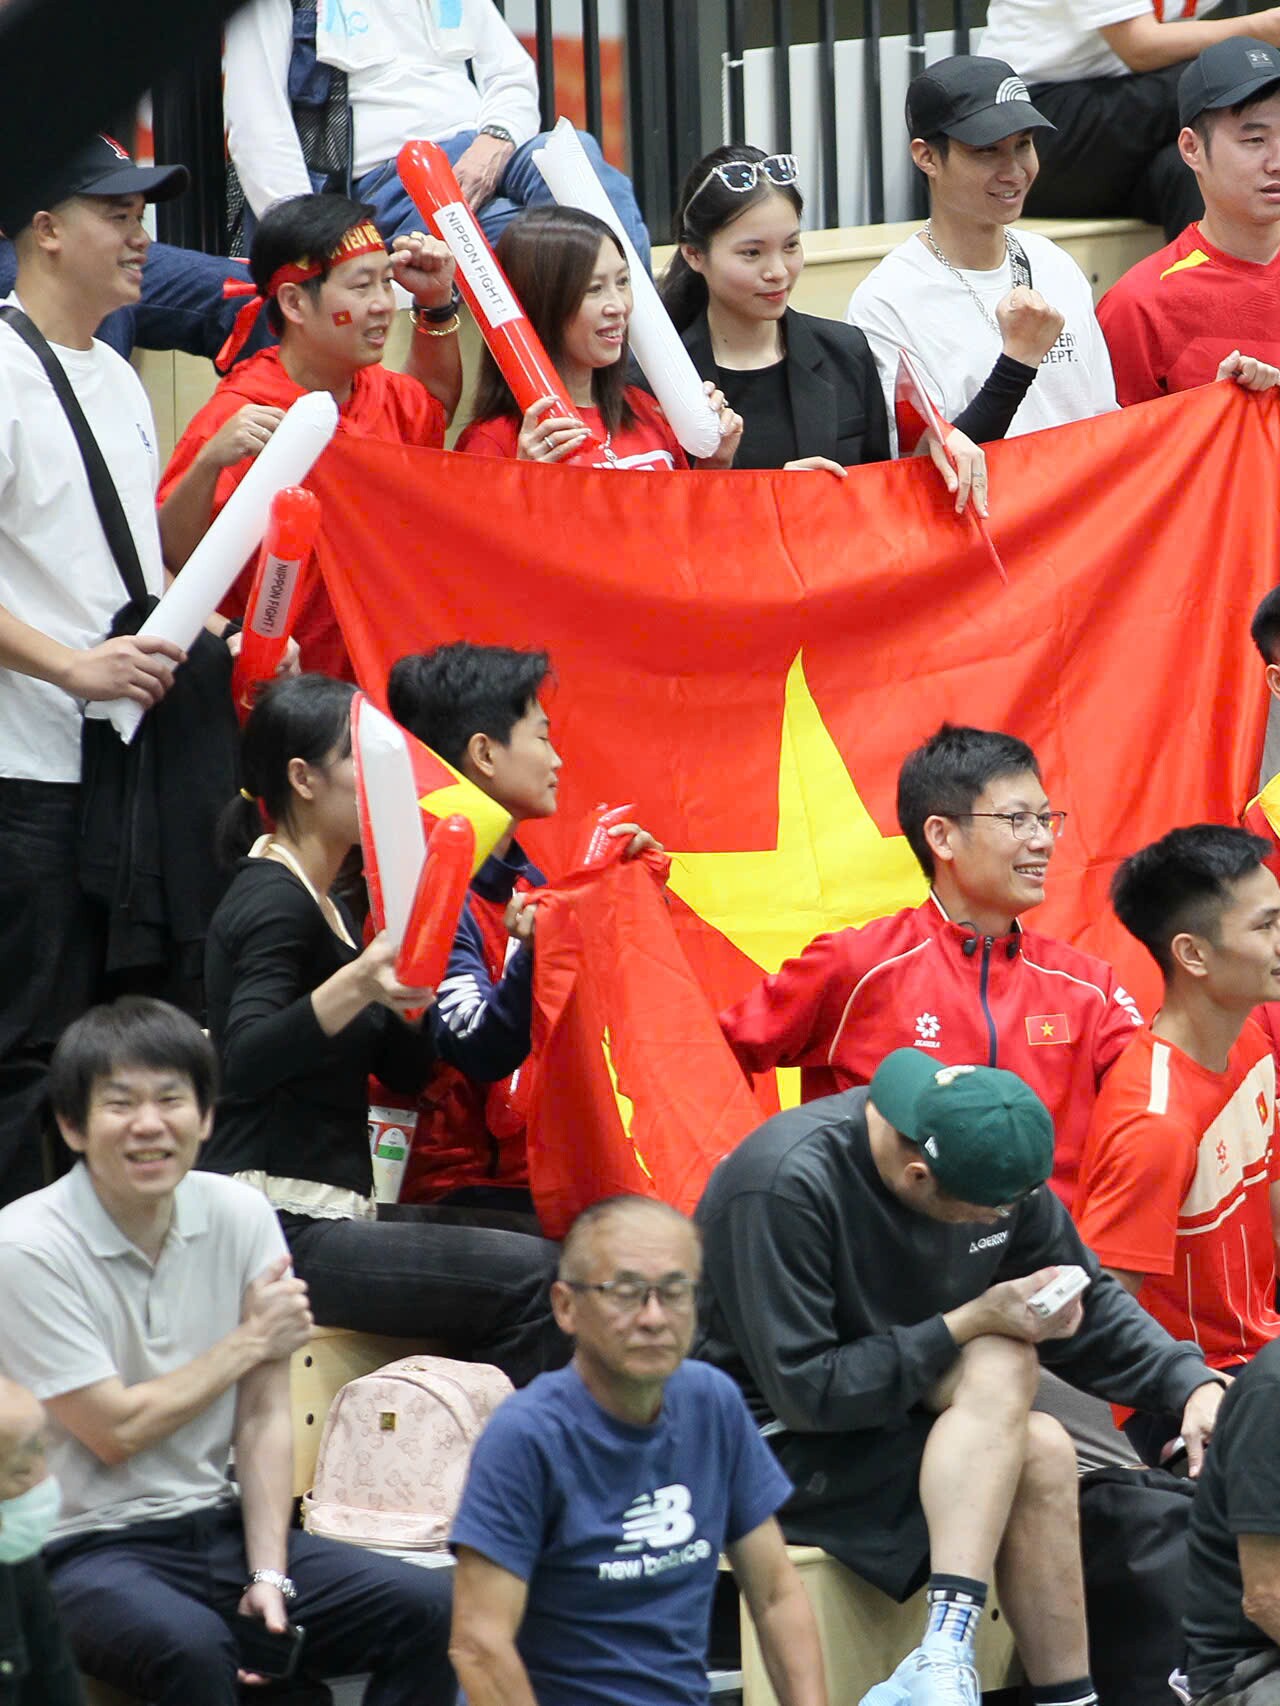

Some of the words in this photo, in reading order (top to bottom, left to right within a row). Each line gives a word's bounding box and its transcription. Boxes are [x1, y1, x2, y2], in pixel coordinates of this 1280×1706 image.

[445, 211, 481, 264] NIPPON
[269, 563, 289, 601] NIPPON
[598, 1560, 643, 1581] new
